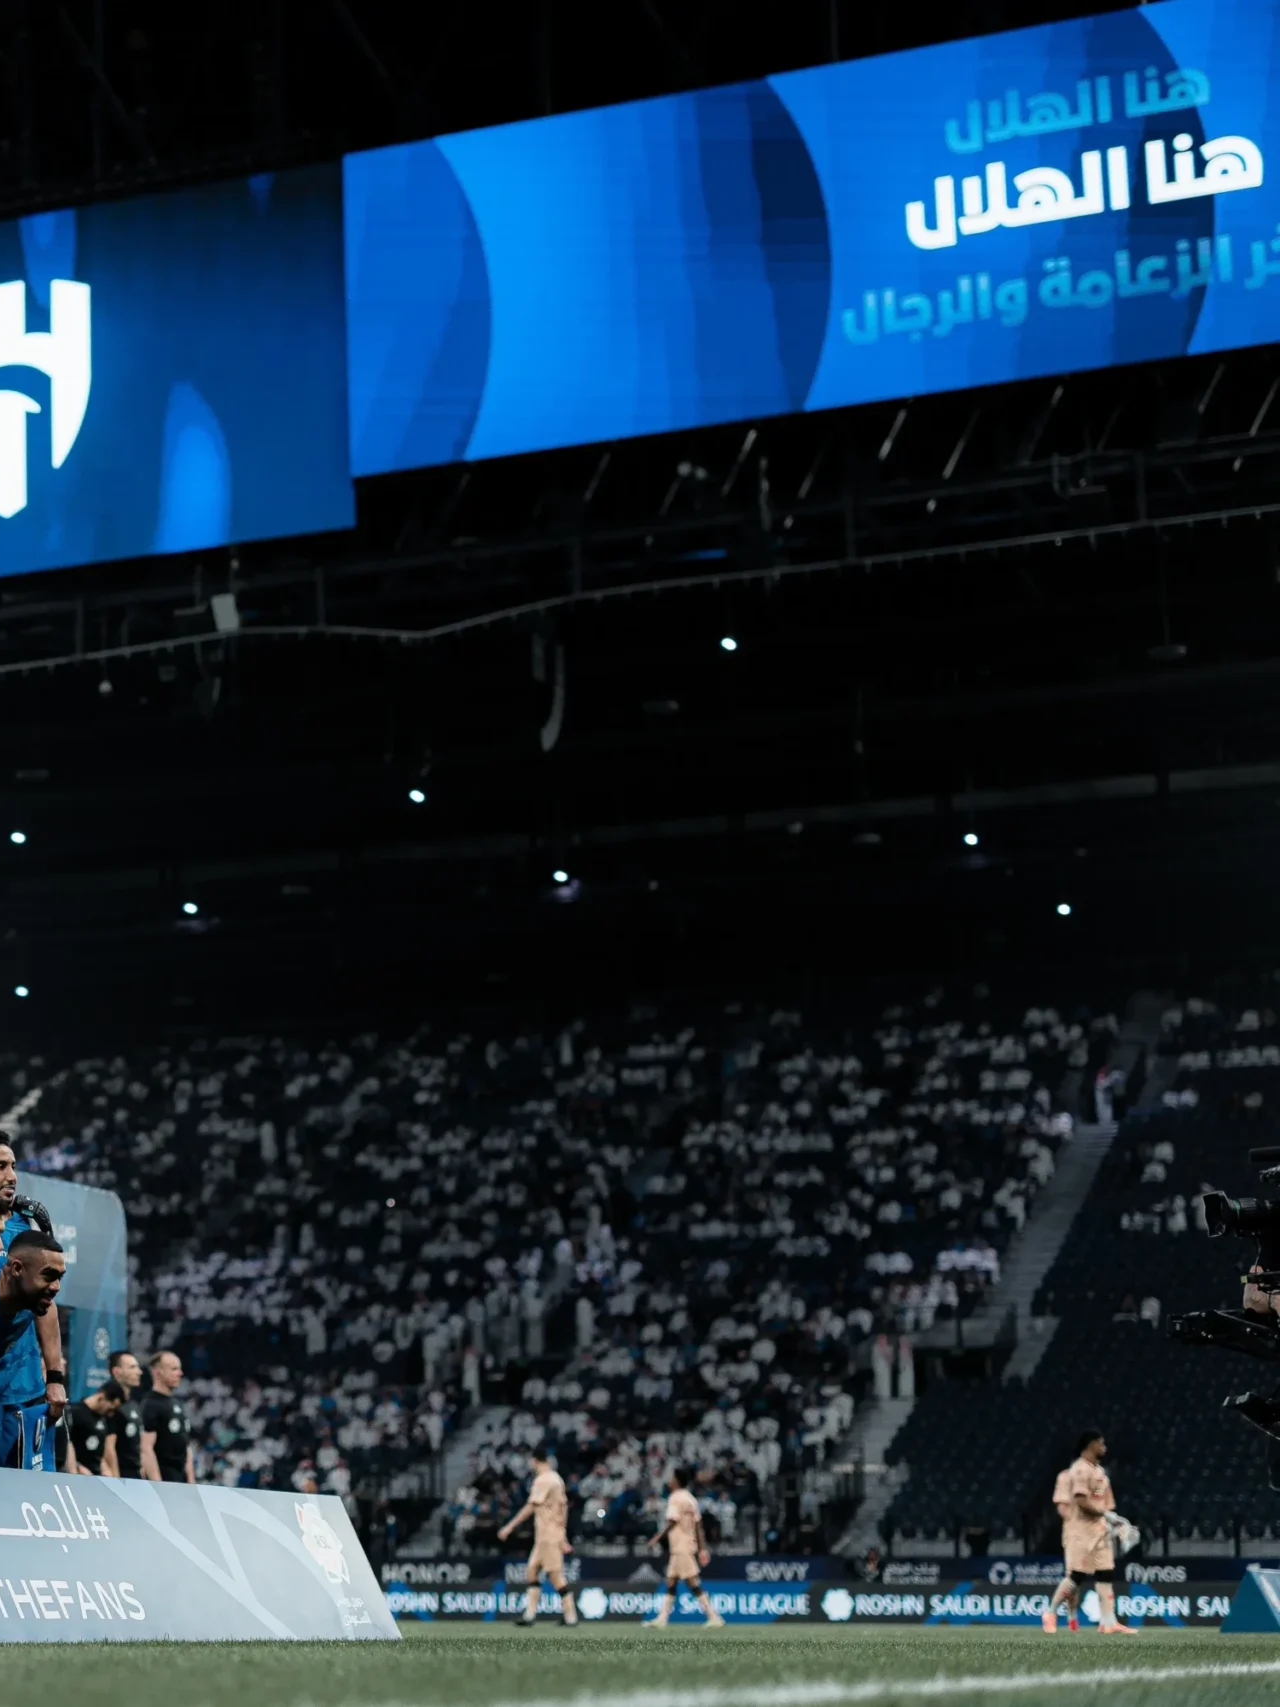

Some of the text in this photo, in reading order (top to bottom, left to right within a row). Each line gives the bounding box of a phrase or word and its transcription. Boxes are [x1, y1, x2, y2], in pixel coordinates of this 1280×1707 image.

[944, 65, 1211, 154] هنا الهلال
[905, 132, 1264, 250] هنا الهلال
[1039, 234, 1233, 309] الزعامة
[841, 272, 1028, 345] والرجال
[381, 1563, 470, 1584] HONOR
[745, 1561, 810, 1582] SAVVY
[738, 1593, 811, 1616] LEAGUE
[855, 1594, 924, 1616] ROSHN
[929, 1594, 990, 1617] SAUDI
[1117, 1595, 1191, 1617] ROSHN
